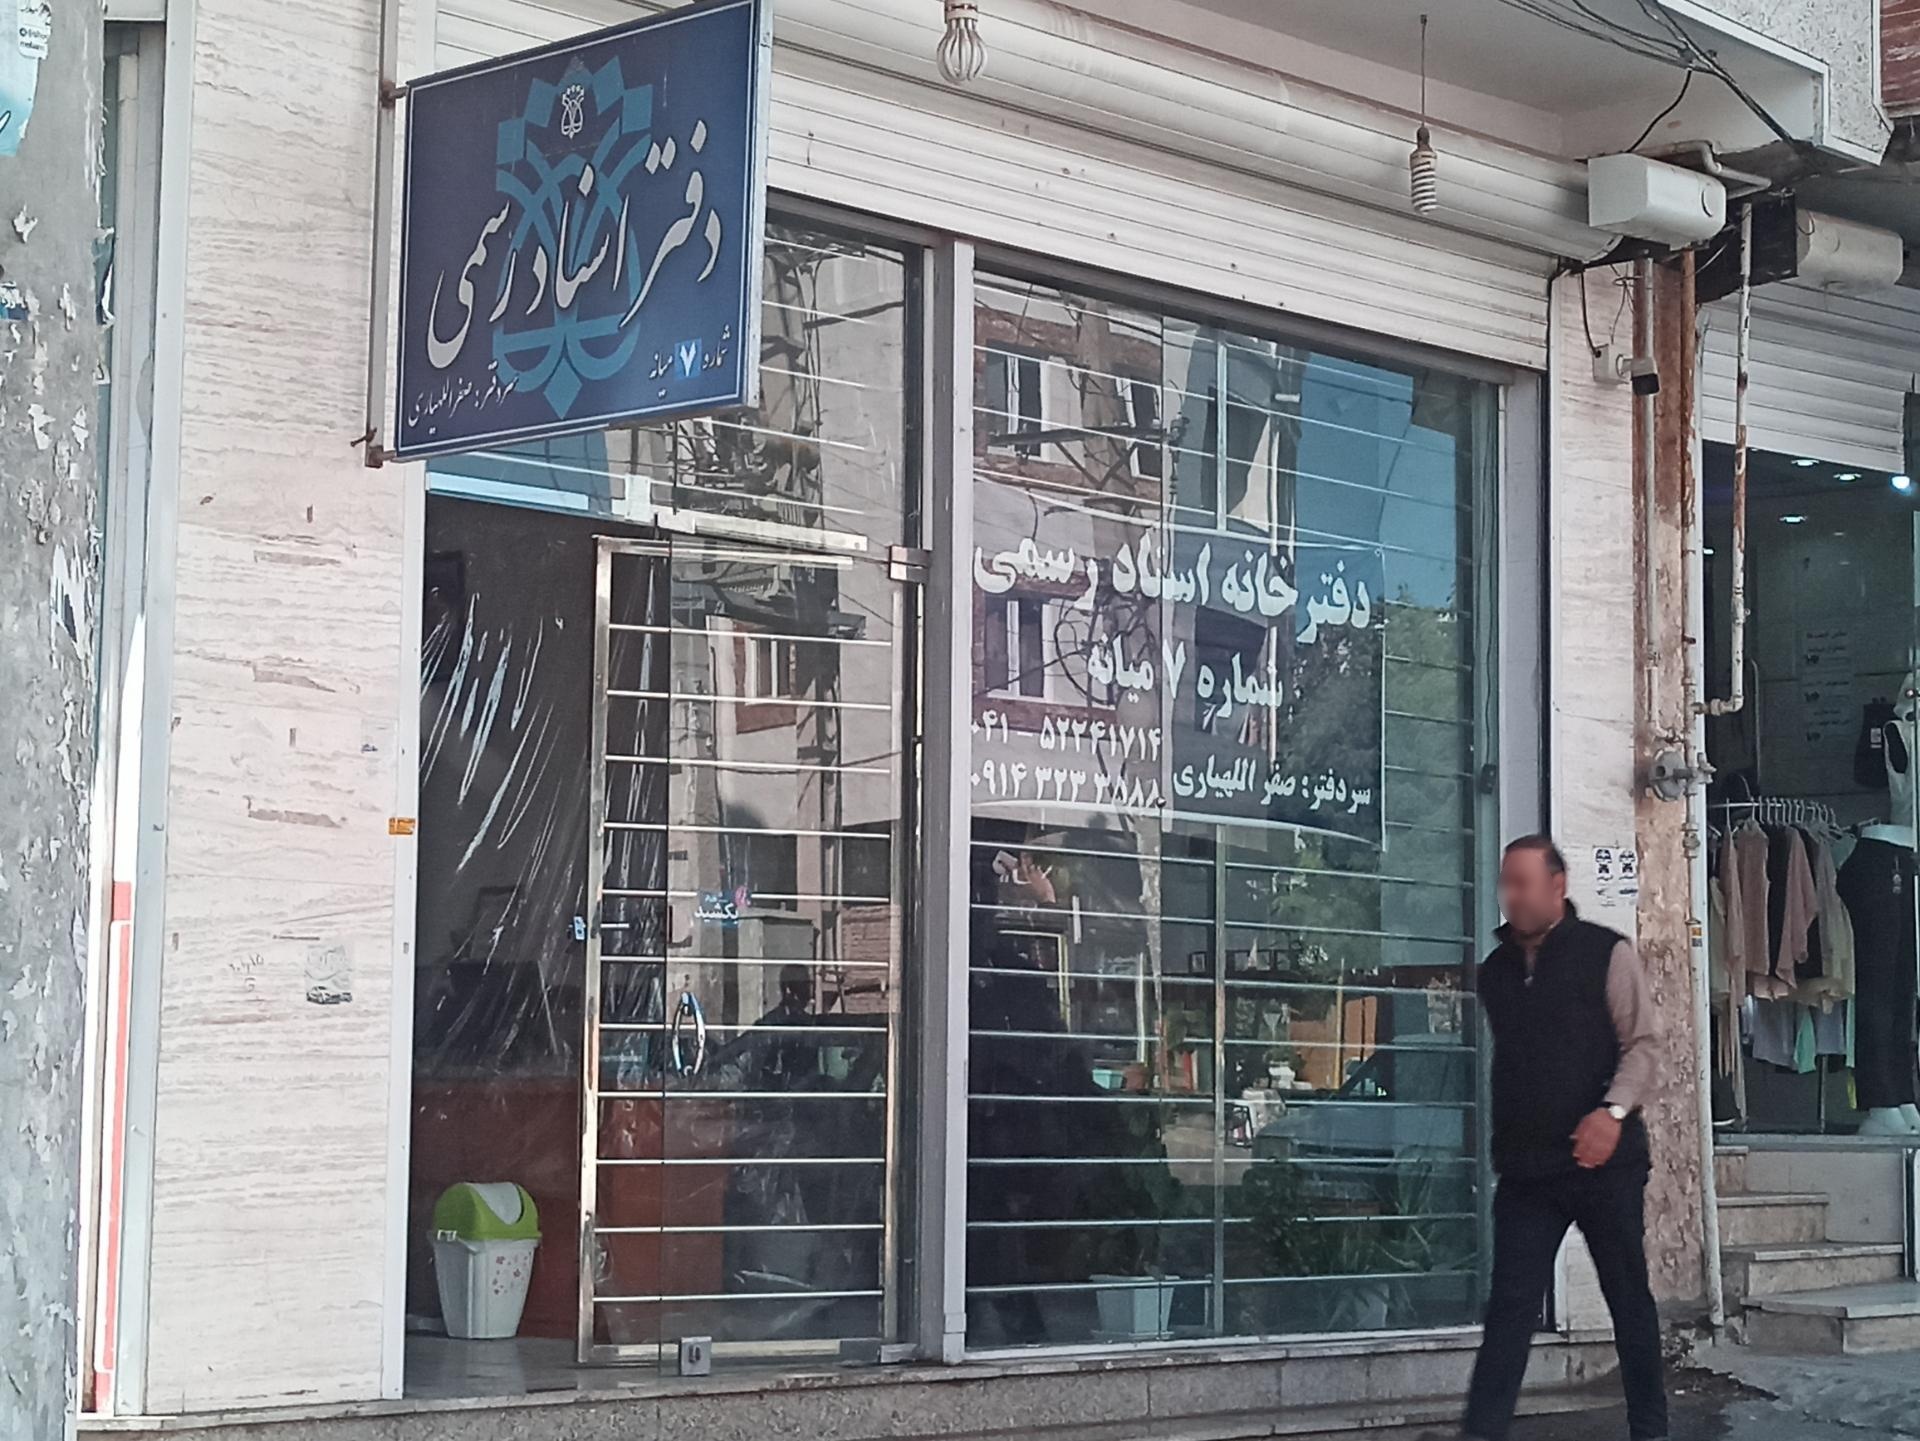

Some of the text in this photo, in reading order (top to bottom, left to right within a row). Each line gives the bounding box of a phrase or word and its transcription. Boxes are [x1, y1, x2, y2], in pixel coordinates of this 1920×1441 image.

[427, 119, 722, 369] دفتر اسناد رسمی
[648, 323, 730, 397] شماره ۷ میانه
[973, 536, 1099, 611] رسمی
[1111, 526, 1212, 607] اسناد
[1087, 631, 1284, 719] شماره ۷ میانه
[1172, 753, 1257, 798] اللهیاری
[1260, 762, 1297, 805] صفر
[694, 902, 739, 925] بکشید
